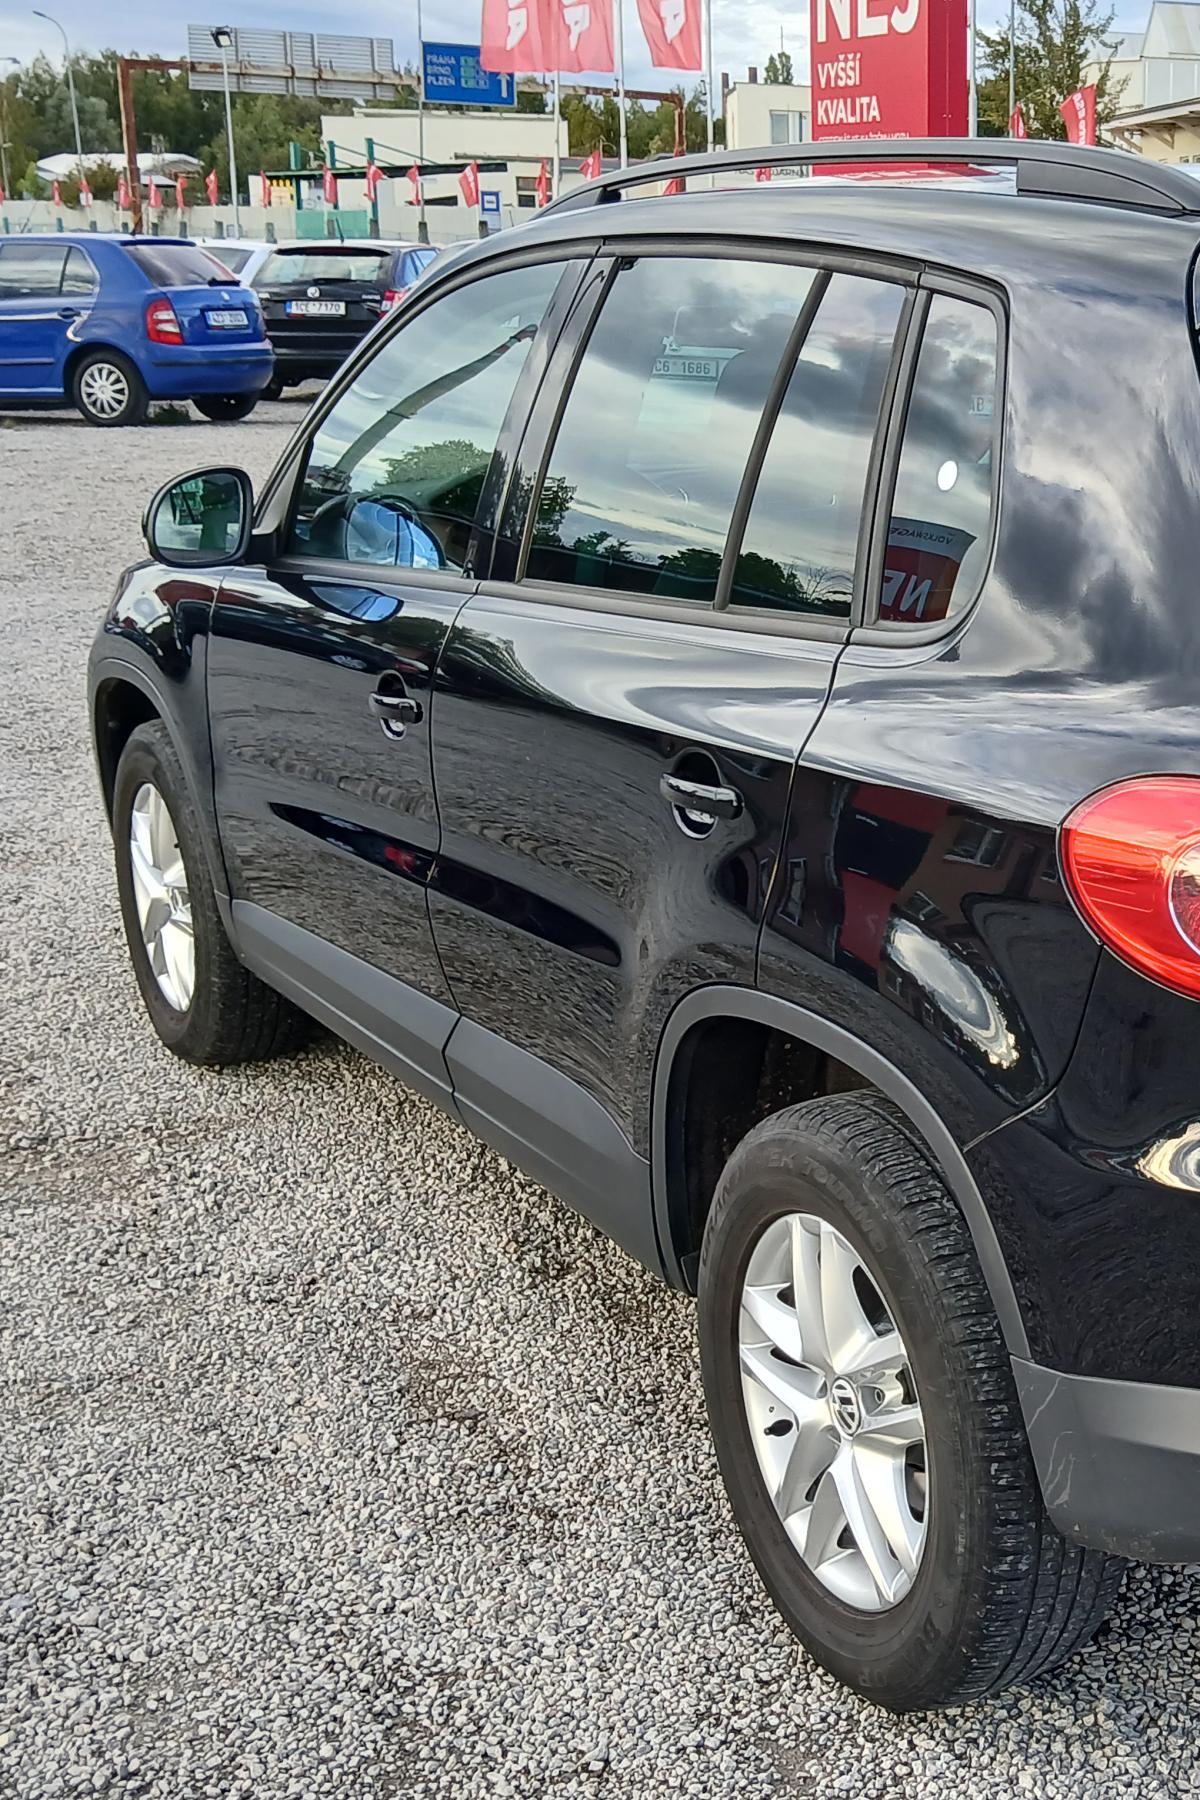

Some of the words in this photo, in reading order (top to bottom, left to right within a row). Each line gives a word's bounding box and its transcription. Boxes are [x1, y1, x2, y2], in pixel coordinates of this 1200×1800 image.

[426, 54, 456, 65] PRAHA
[817, 53, 861, 89] VYŠŠÍ
[817, 95, 881, 125] KVALITA
[681, 361, 711, 375] 1686
